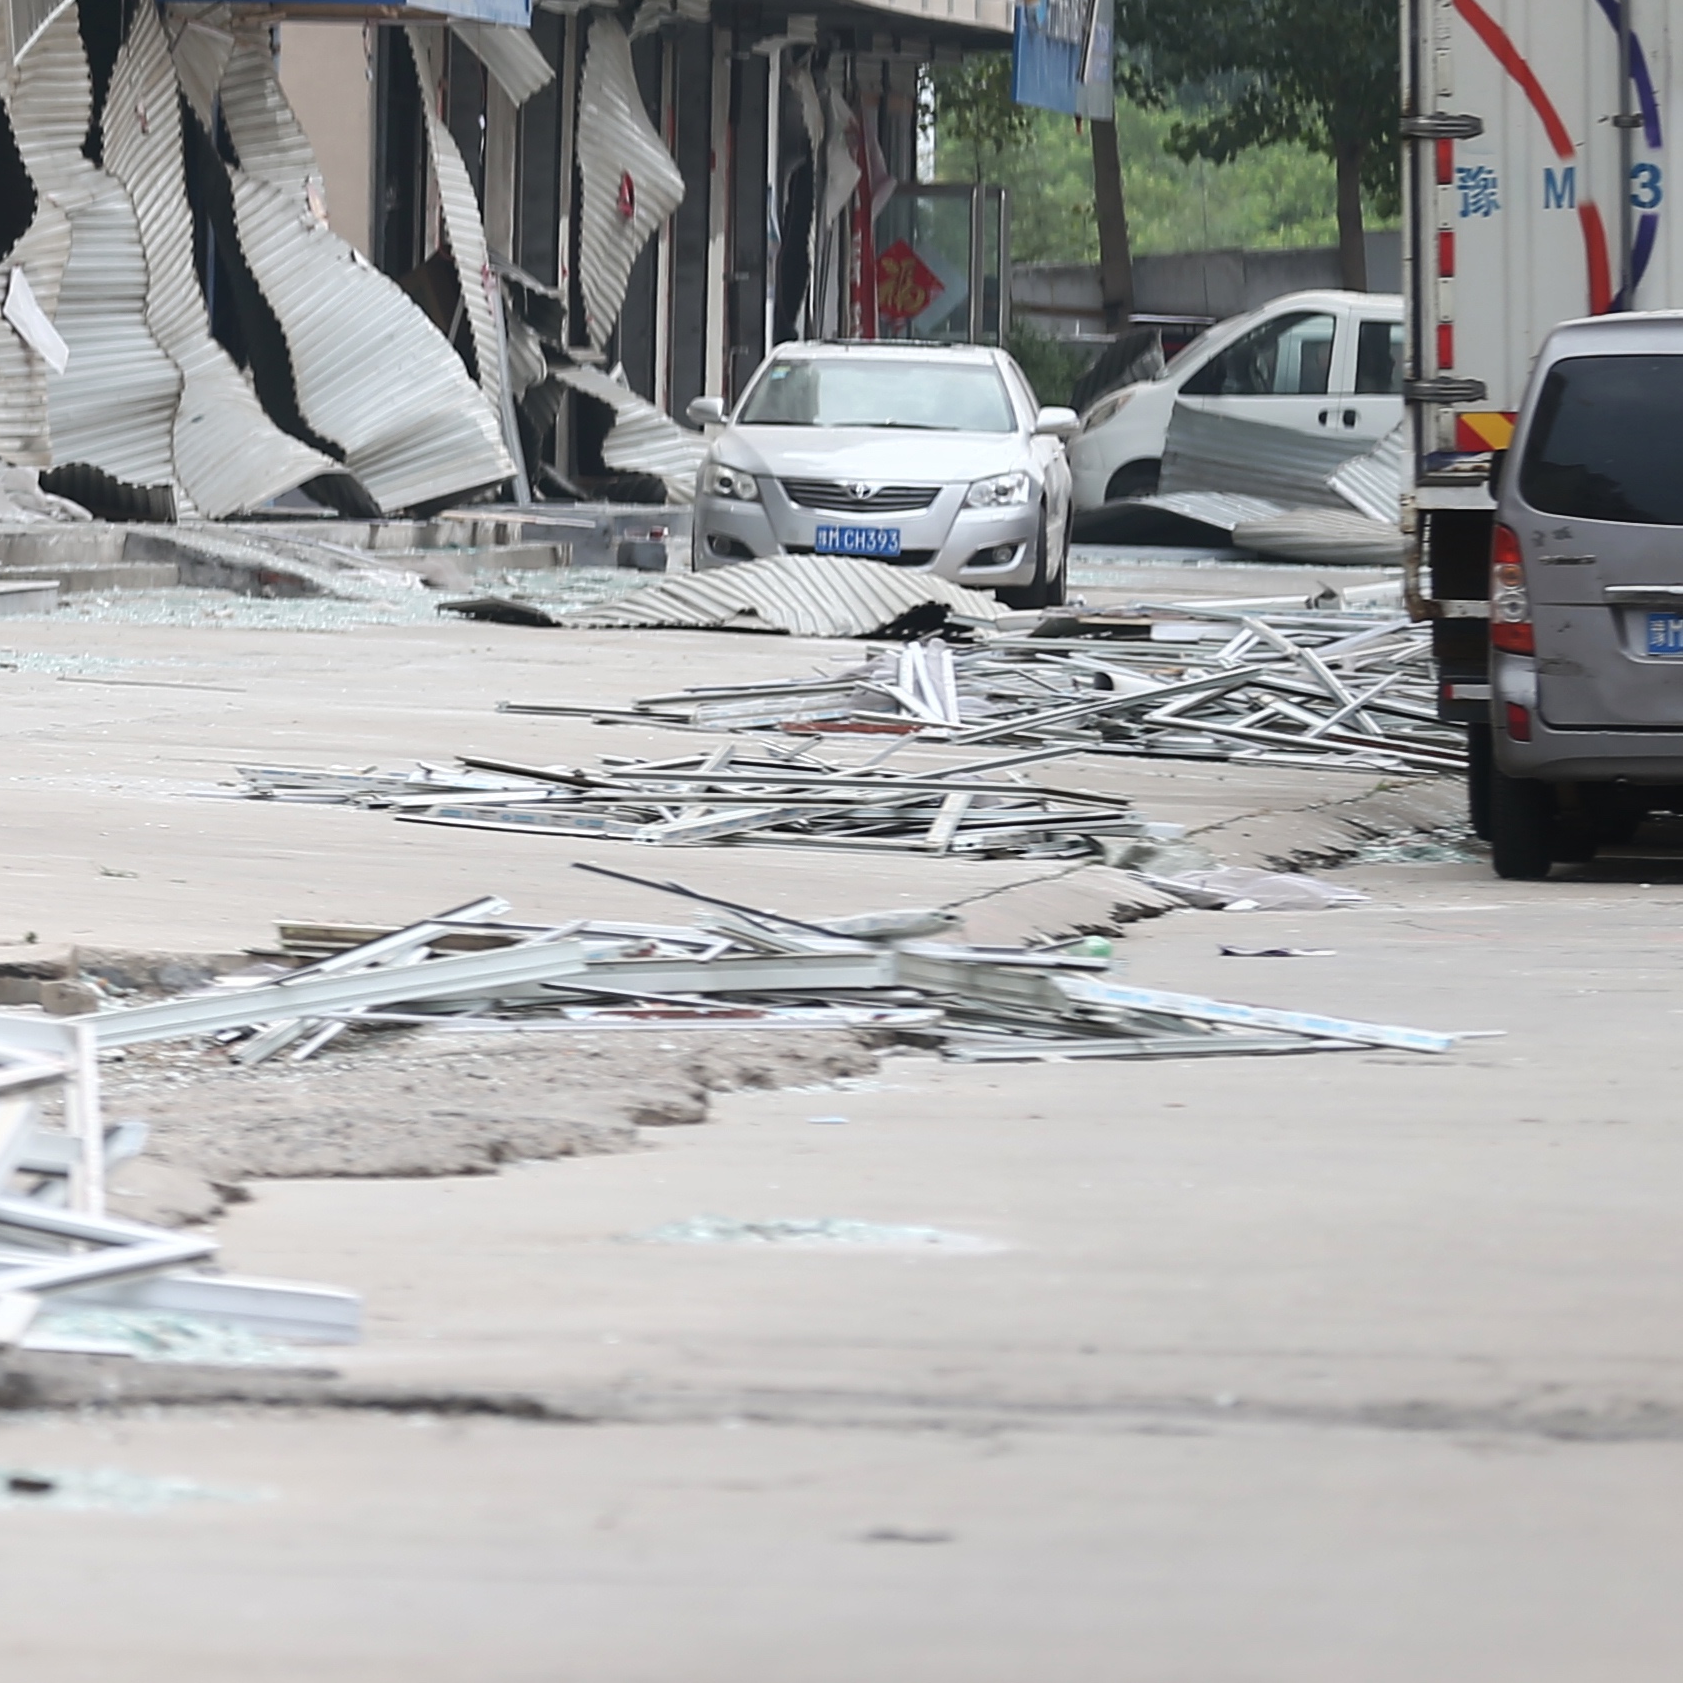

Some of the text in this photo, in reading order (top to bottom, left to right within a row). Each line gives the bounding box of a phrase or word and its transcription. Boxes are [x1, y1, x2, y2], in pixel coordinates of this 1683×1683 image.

[1455, 162, 1664, 218] 豫 M 3
